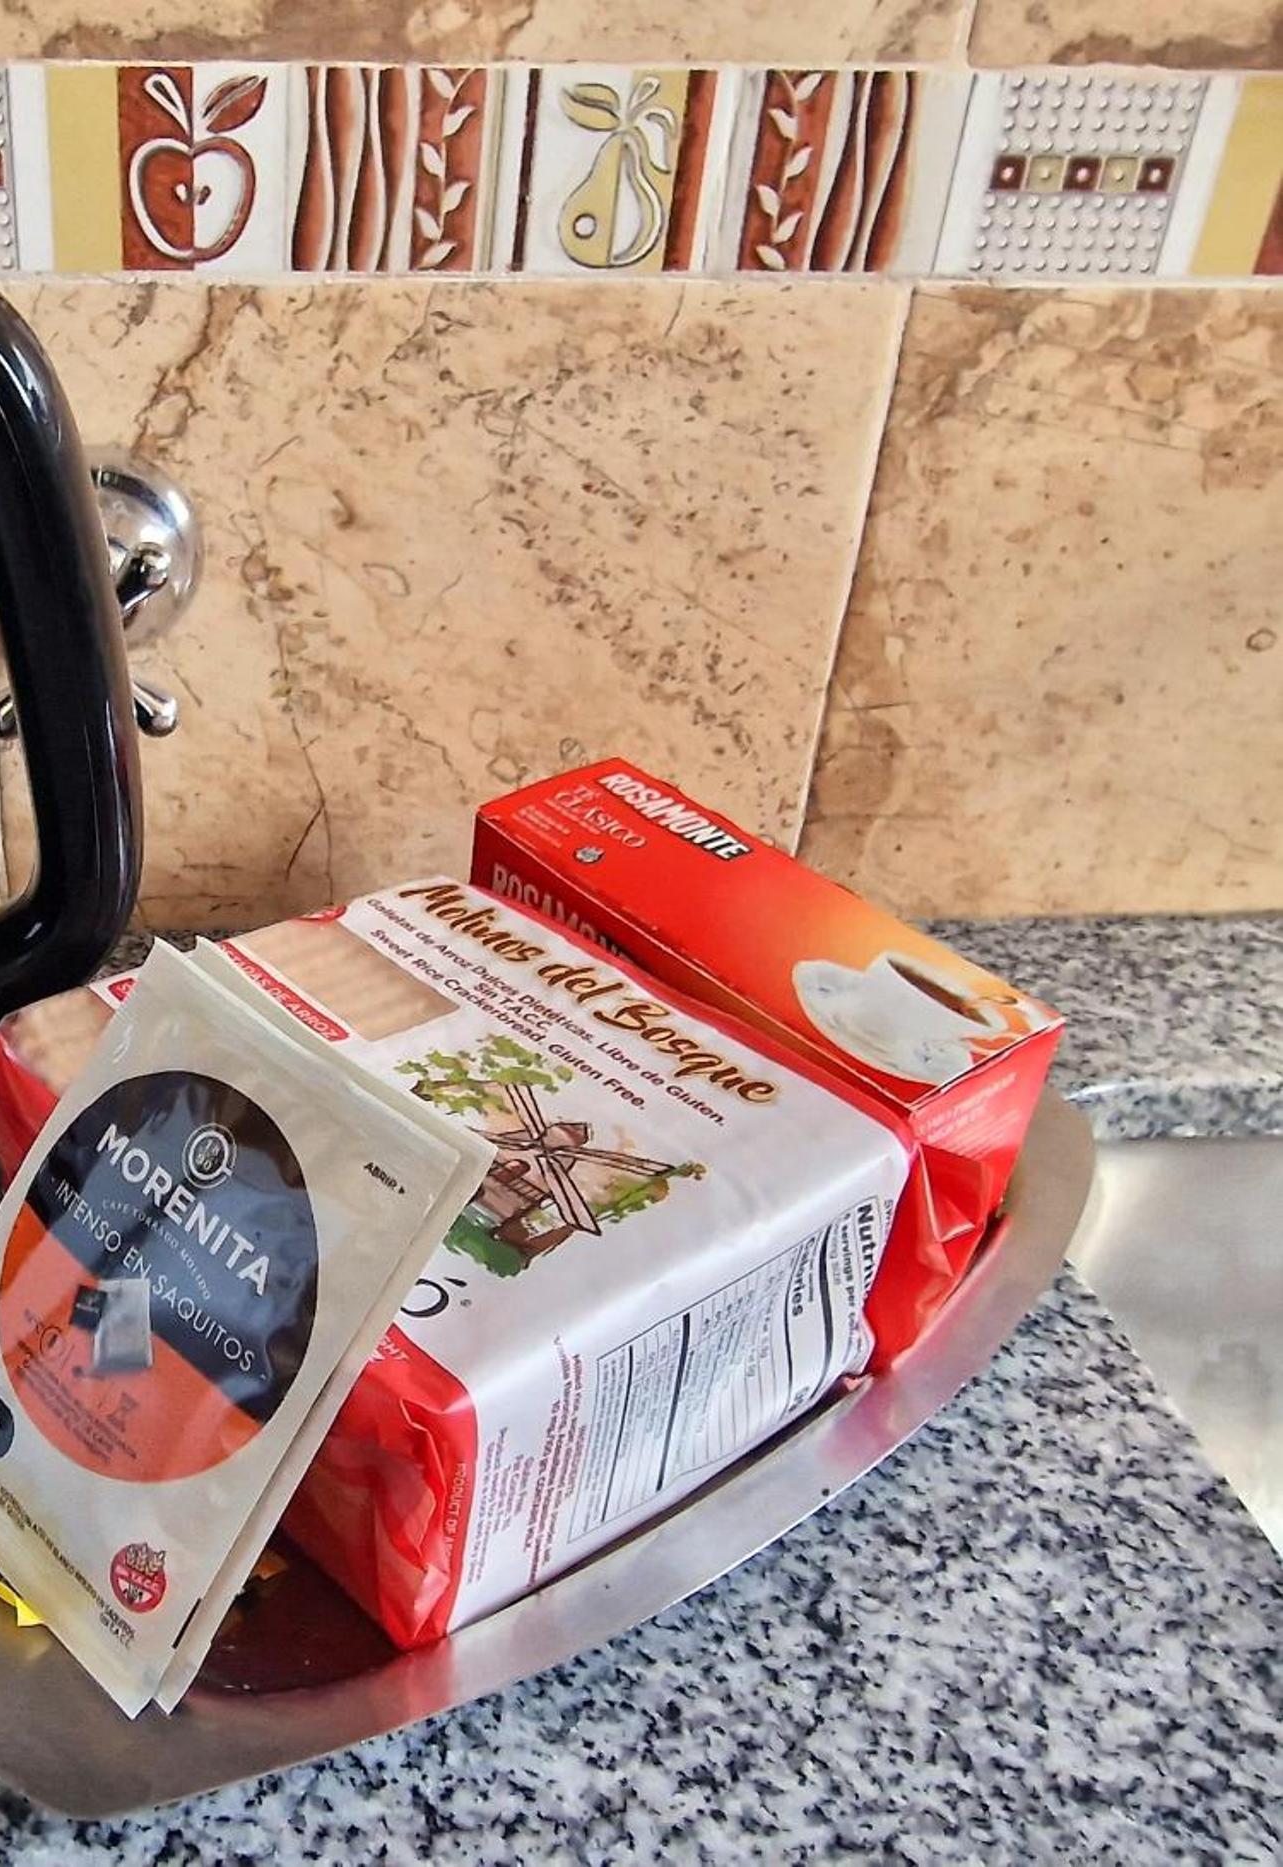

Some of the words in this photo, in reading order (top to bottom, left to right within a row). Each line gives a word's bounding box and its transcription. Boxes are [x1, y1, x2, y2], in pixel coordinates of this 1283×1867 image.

[597, 772, 751, 861] ROSAMONTE
[285, 1002, 339, 1041] ARROZ
[367, 898, 416, 933] Galletas
[415, 930, 436, 946] de
[434, 944, 474, 968] Arroz
[472, 965, 520, 997] Dulces
[596, 1041, 641, 1072] Libre
[639, 1069, 665, 1087] de
[665, 1084, 725, 1127] Gluten.
[370, 928, 414, 960] Sweet
[412, 957, 445, 982] Rice
[443, 978, 547, 1046] Crackerbread.
[547, 1042, 604, 1081] Gluten
[602, 1077, 646, 1110] Free.
[399, 884, 545, 962] Molinos
[538, 964, 624, 1004] del
[593, 997, 775, 1104] Bosque
[473, 981, 498, 1000] Sin
[95, 1122, 271, 1297] MORENITA
[364, 1161, 398, 1192] ABRIR
[55, 1178, 122, 1253] INTENSO
[122, 1244, 152, 1280] EN
[152, 1274, 256, 1373] SAQUITOS
[792, 1236, 816, 1318] Calories
[841, 1225, 855, 1282] servings
[447, 1463, 467, 1516] PRODUCT
